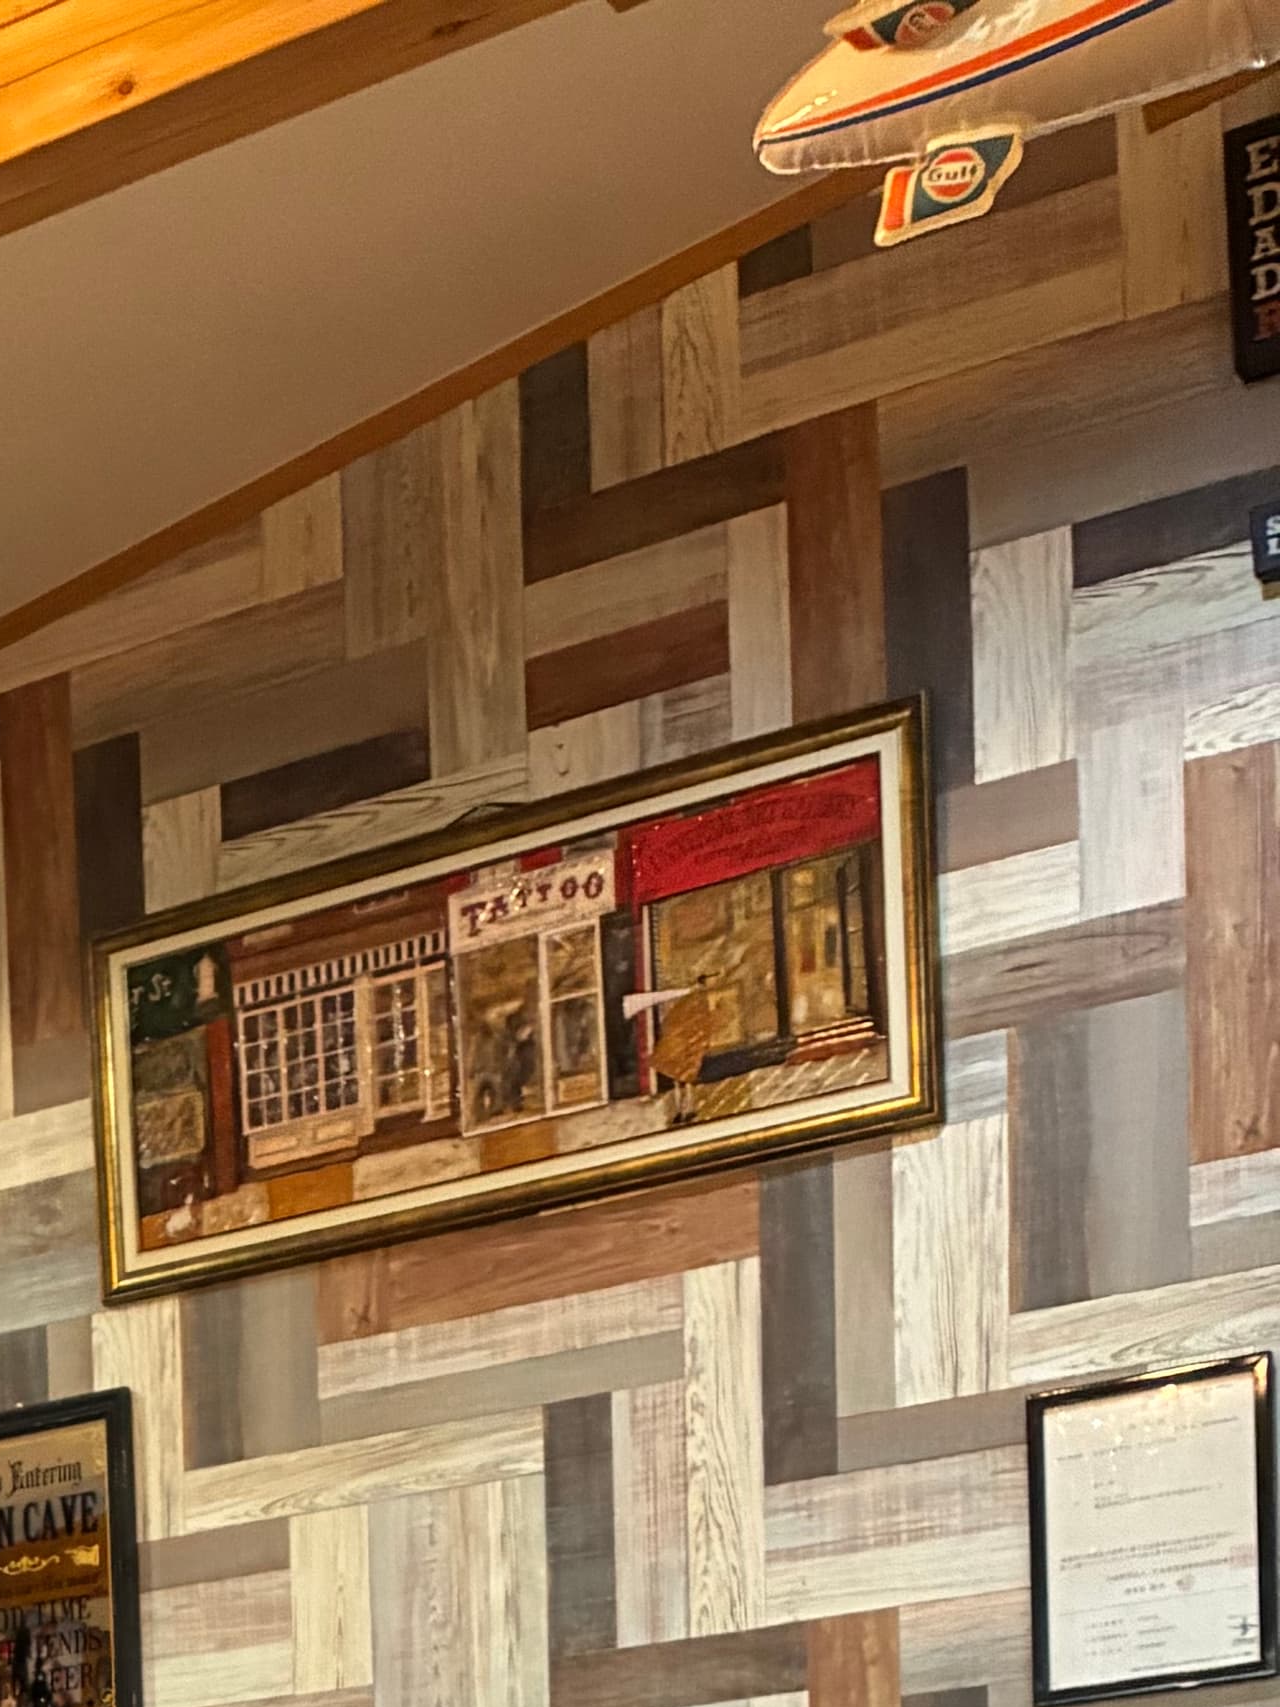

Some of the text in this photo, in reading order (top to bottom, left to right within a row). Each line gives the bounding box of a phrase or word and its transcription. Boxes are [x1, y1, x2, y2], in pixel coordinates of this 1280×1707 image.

[927, 161, 980, 185] Gulf
[460, 871, 606, 937] TATTOO
[6, 1457, 83, 1499] Entering
[22, 1491, 99, 1545] CAVE
